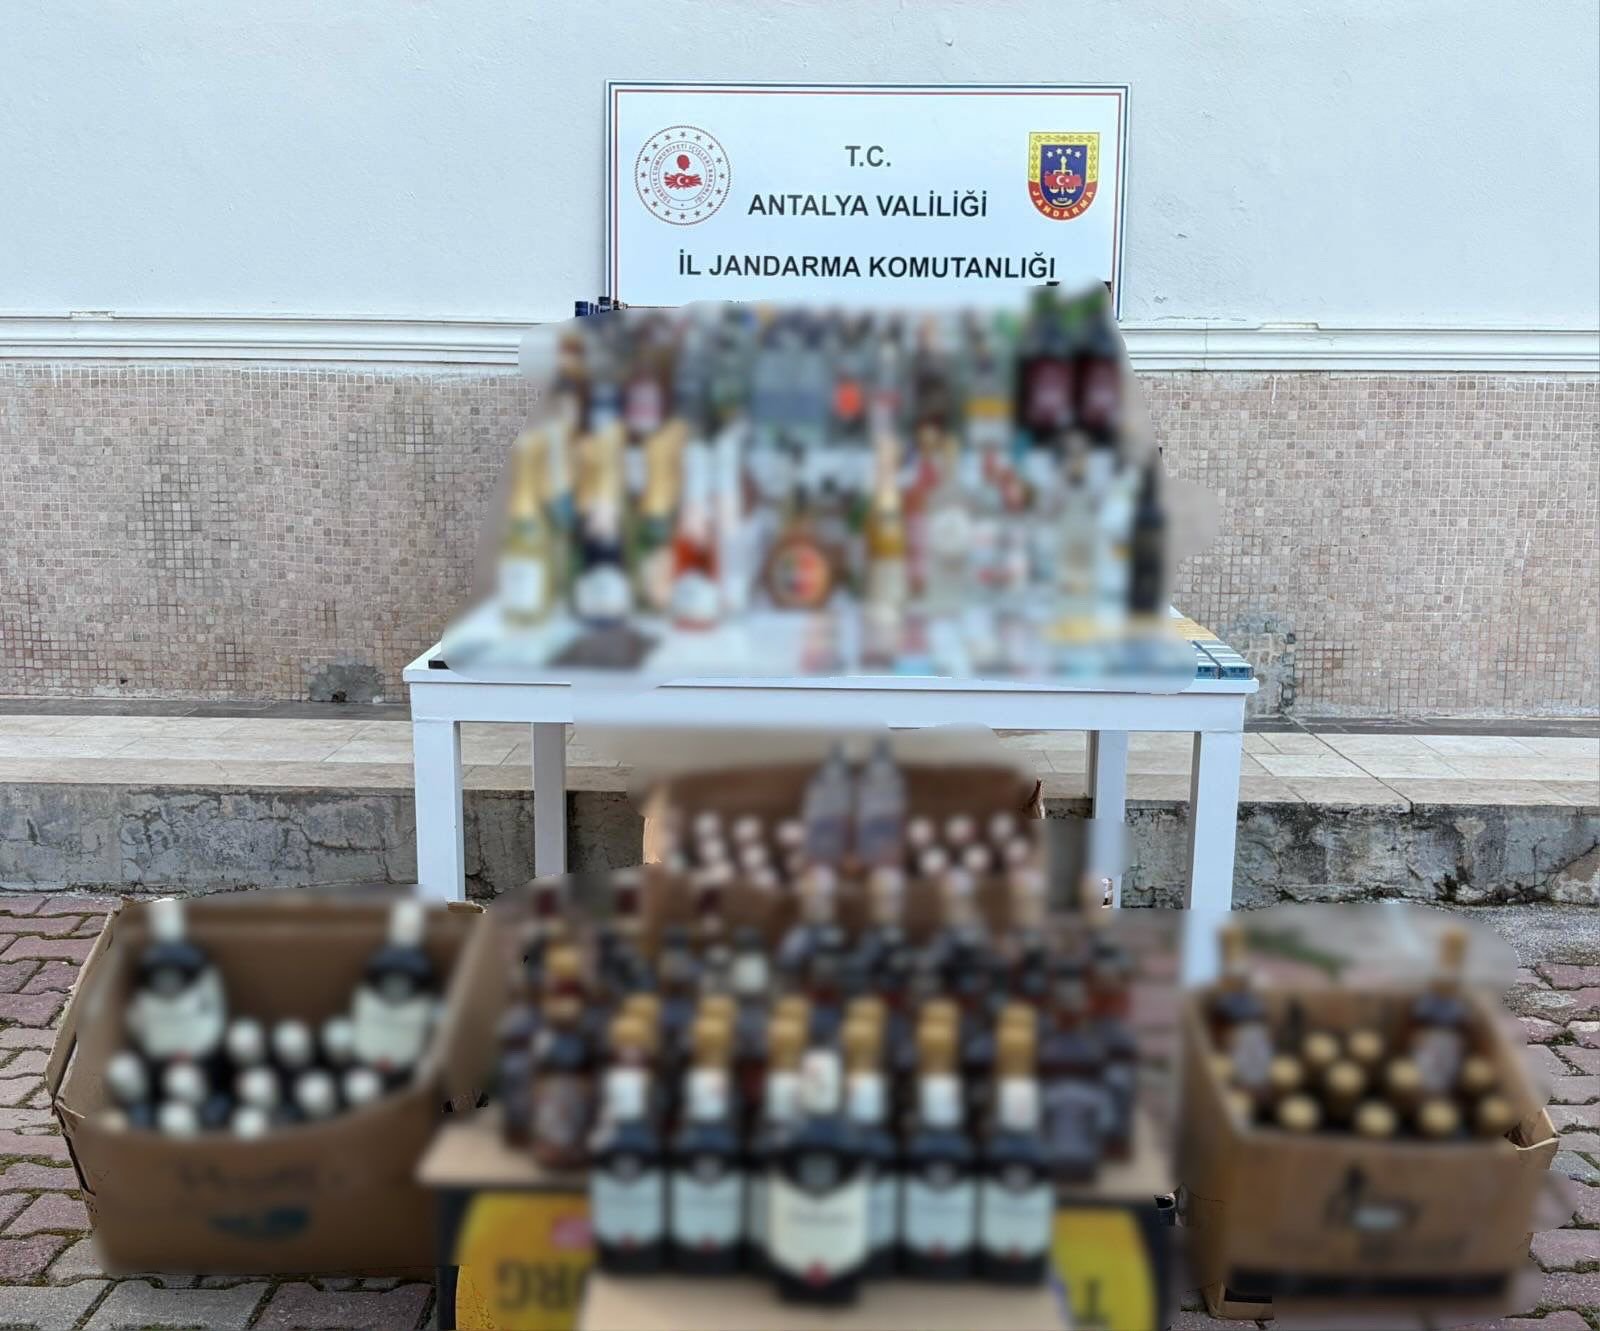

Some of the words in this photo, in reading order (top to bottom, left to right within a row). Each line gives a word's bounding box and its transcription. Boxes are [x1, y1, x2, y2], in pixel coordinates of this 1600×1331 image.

[845, 145, 891, 167] T.C.
[748, 194, 869, 217] ANTALYA
[876, 190, 987, 217] VALİLİĞİ
[1032, 190, 1094, 218] JANDARMA
[679, 248, 702, 276] İL
[709, 255, 861, 278] JANDARMA
[869, 251, 1055, 279] KOMUTANLIĞI
